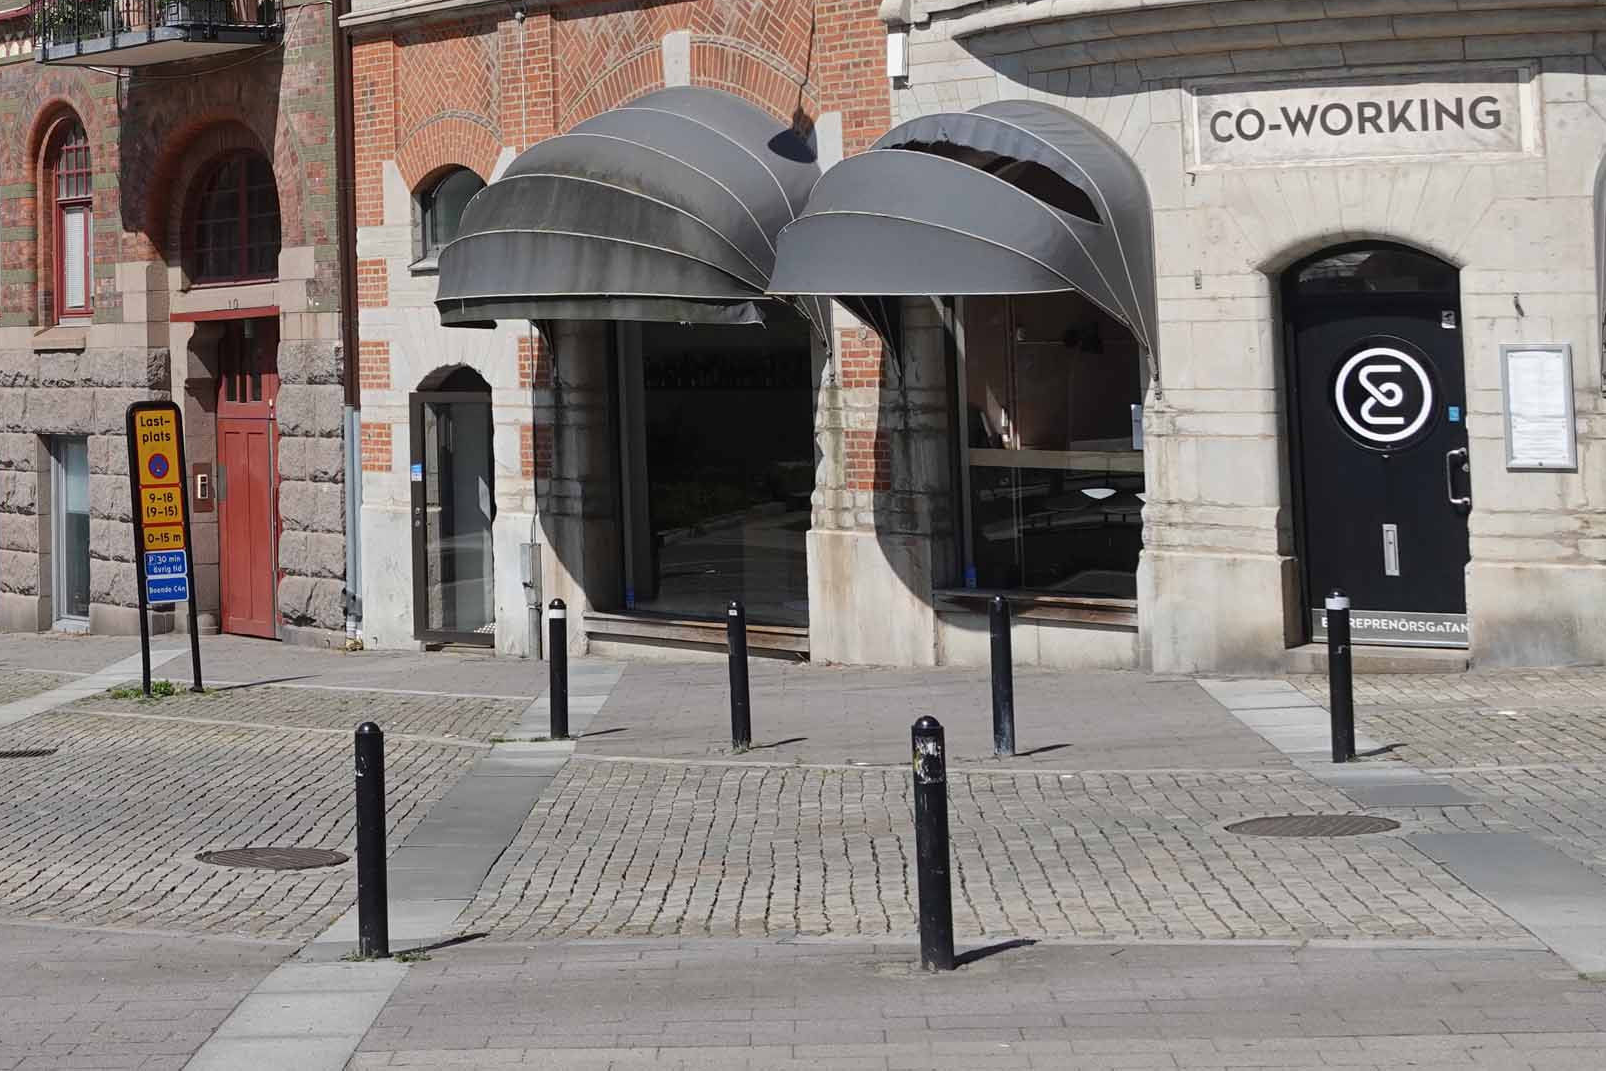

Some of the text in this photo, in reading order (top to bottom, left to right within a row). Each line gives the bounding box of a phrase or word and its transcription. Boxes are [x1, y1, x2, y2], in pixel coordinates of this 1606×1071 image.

[1209, 95, 1503, 143] CO-WORKING
[140, 416, 171, 427] Last-
[142, 431, 171, 445] plats
[149, 492, 174, 503] 9-18
[146, 505, 178, 518] (9-15)
[147, 532, 181, 543] 0-15 m
[157, 555, 167, 563] 30
[168, 554, 181, 562] min
[1321, 617, 1469, 633] EREPRENÖRSGATAN
